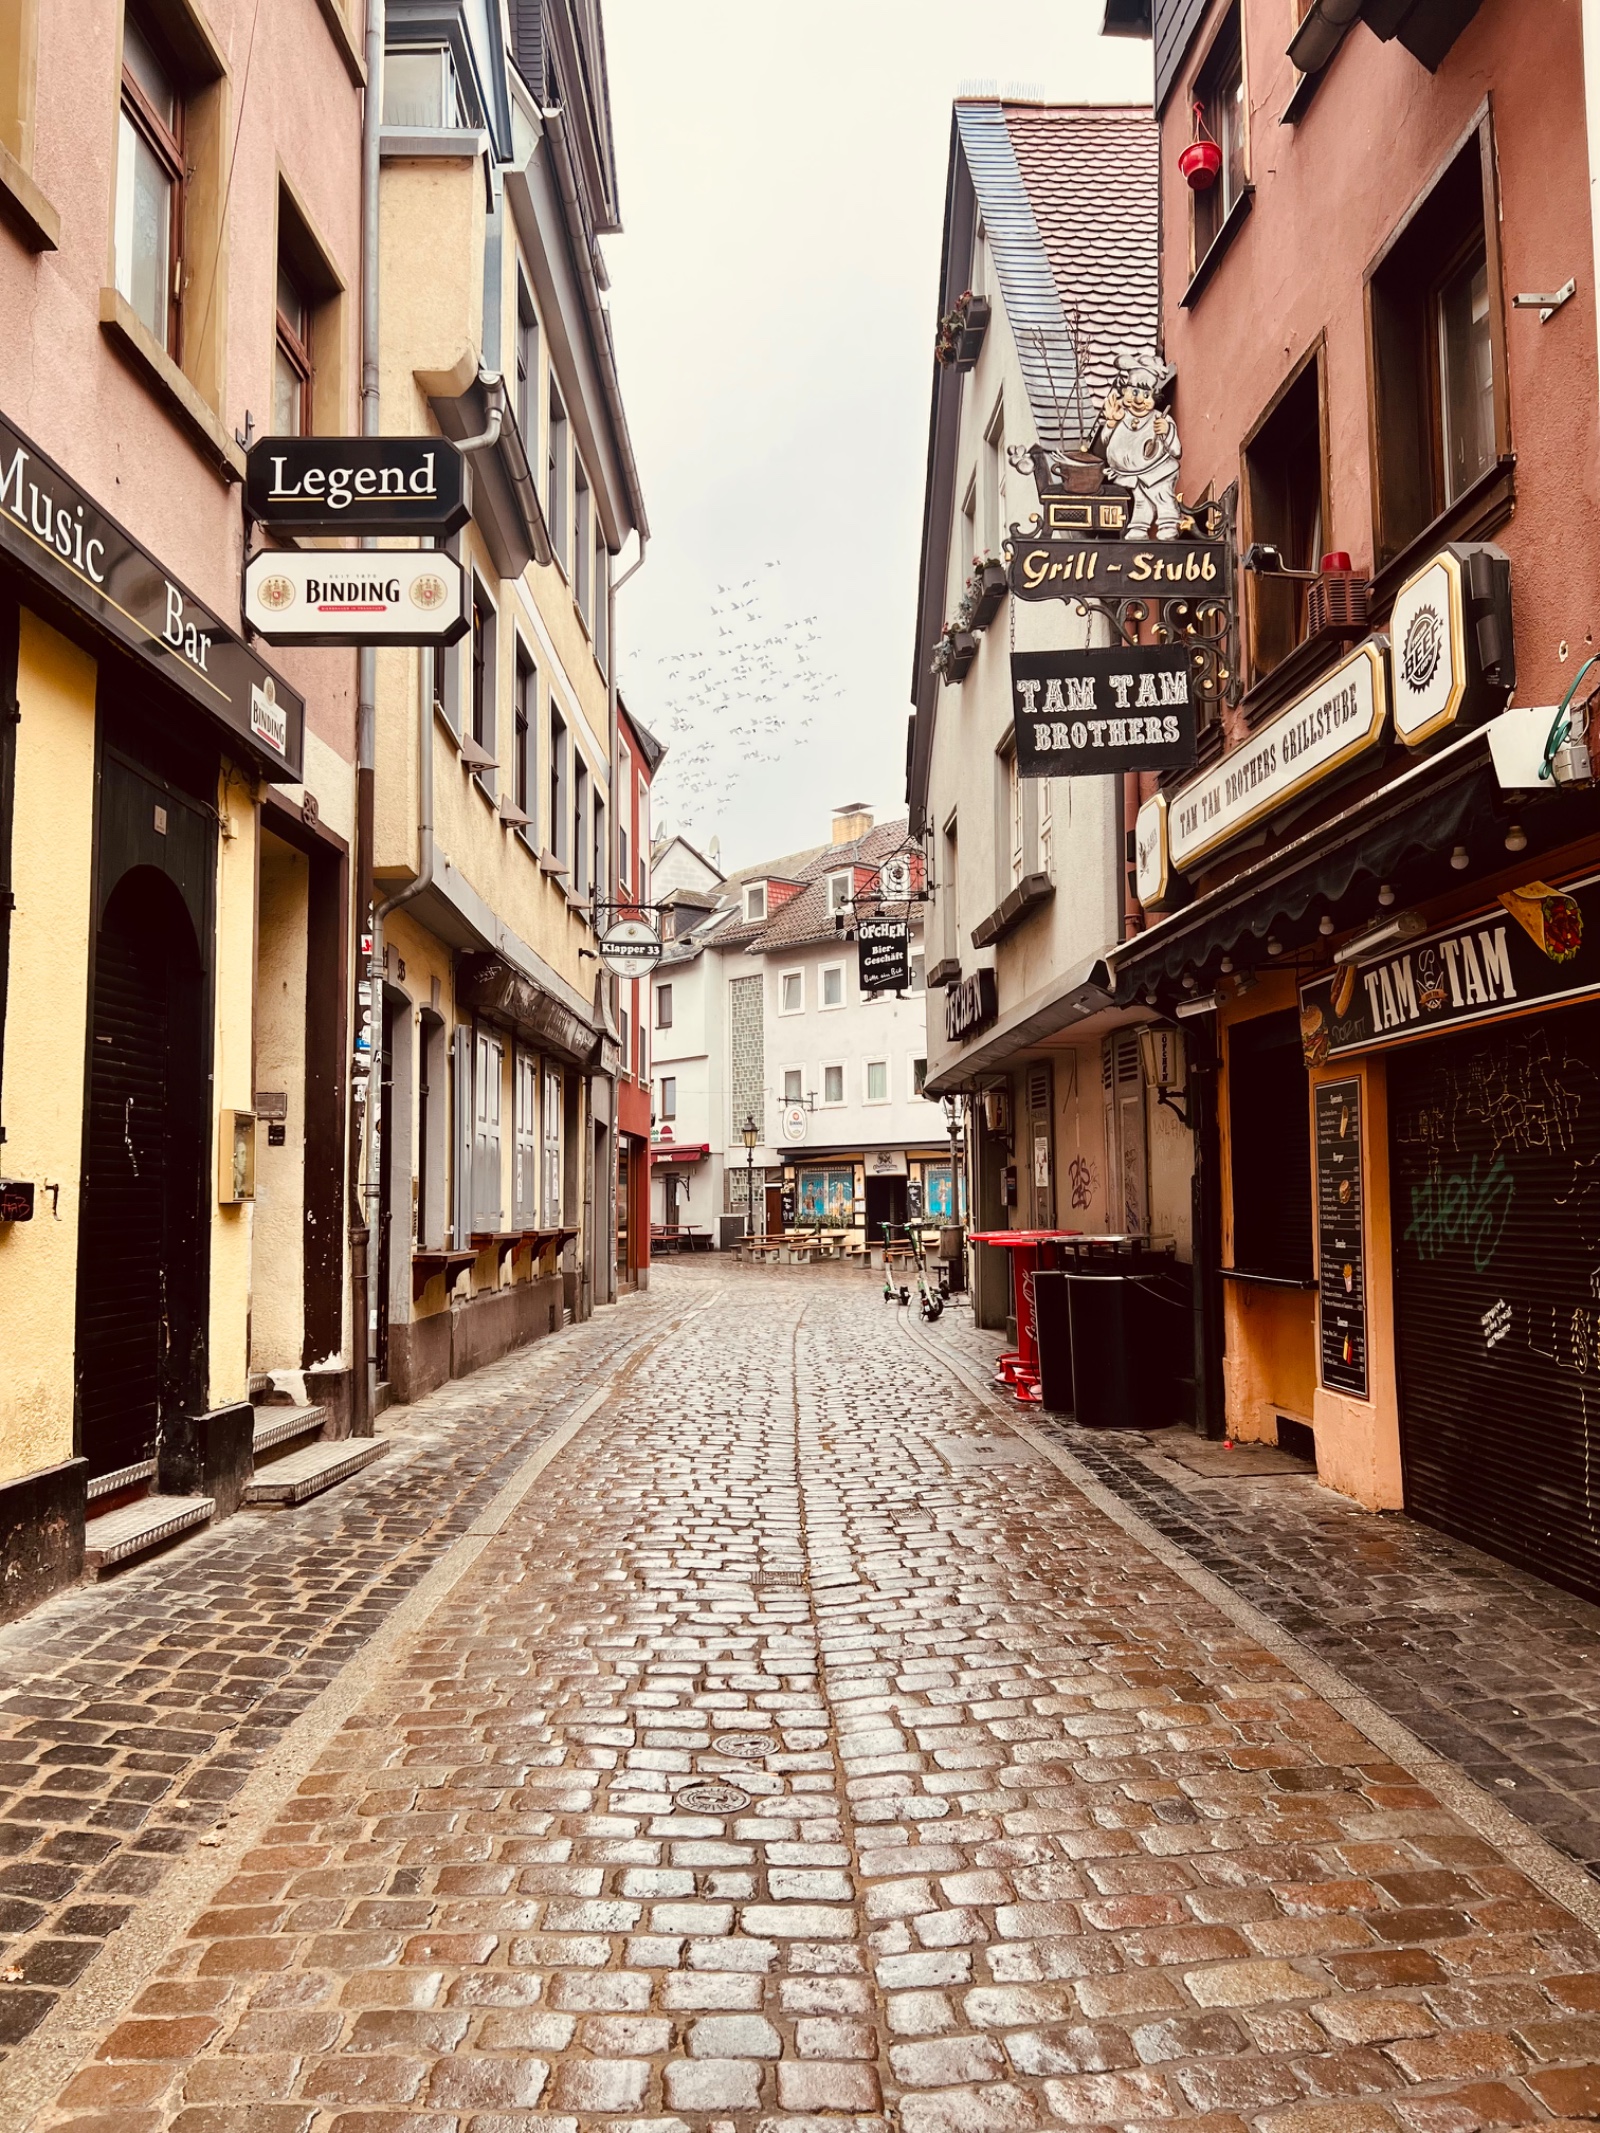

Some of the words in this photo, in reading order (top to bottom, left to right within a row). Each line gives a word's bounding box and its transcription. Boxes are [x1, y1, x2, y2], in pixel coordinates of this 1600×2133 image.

[268, 452, 437, 509] Legend
[0, 447, 105, 583] Music
[162, 580, 212, 672] Bar
[1023, 550, 1098, 589] Grill
[1128, 551, 1217, 581] Stubb
[306, 579, 400, 603] BINDING
[1404, 615, 1441, 681] BEEF
[1017, 676, 1097, 714] TAM
[1109, 671, 1189, 709] TAM
[253, 700, 285, 745] BINDING
[1034, 715, 1180, 752] BROTHERS
[1179, 803, 1198, 839] TAM
[1201, 785, 1221, 823] TAM
[1225, 743, 1277, 807] BROTHERS
[1282, 681, 1358, 765] GRILLSTUBE
[602, 943, 645, 955] Klapper
[647, 946, 660, 955] 33
[860, 922, 906, 939] ÖFCHEN
[872, 945, 894, 955] Bier-
[864, 952, 904, 966] Geschäft
[1363, 954, 1420, 1033] TAM
[1439, 926, 1517, 1008] TAM
